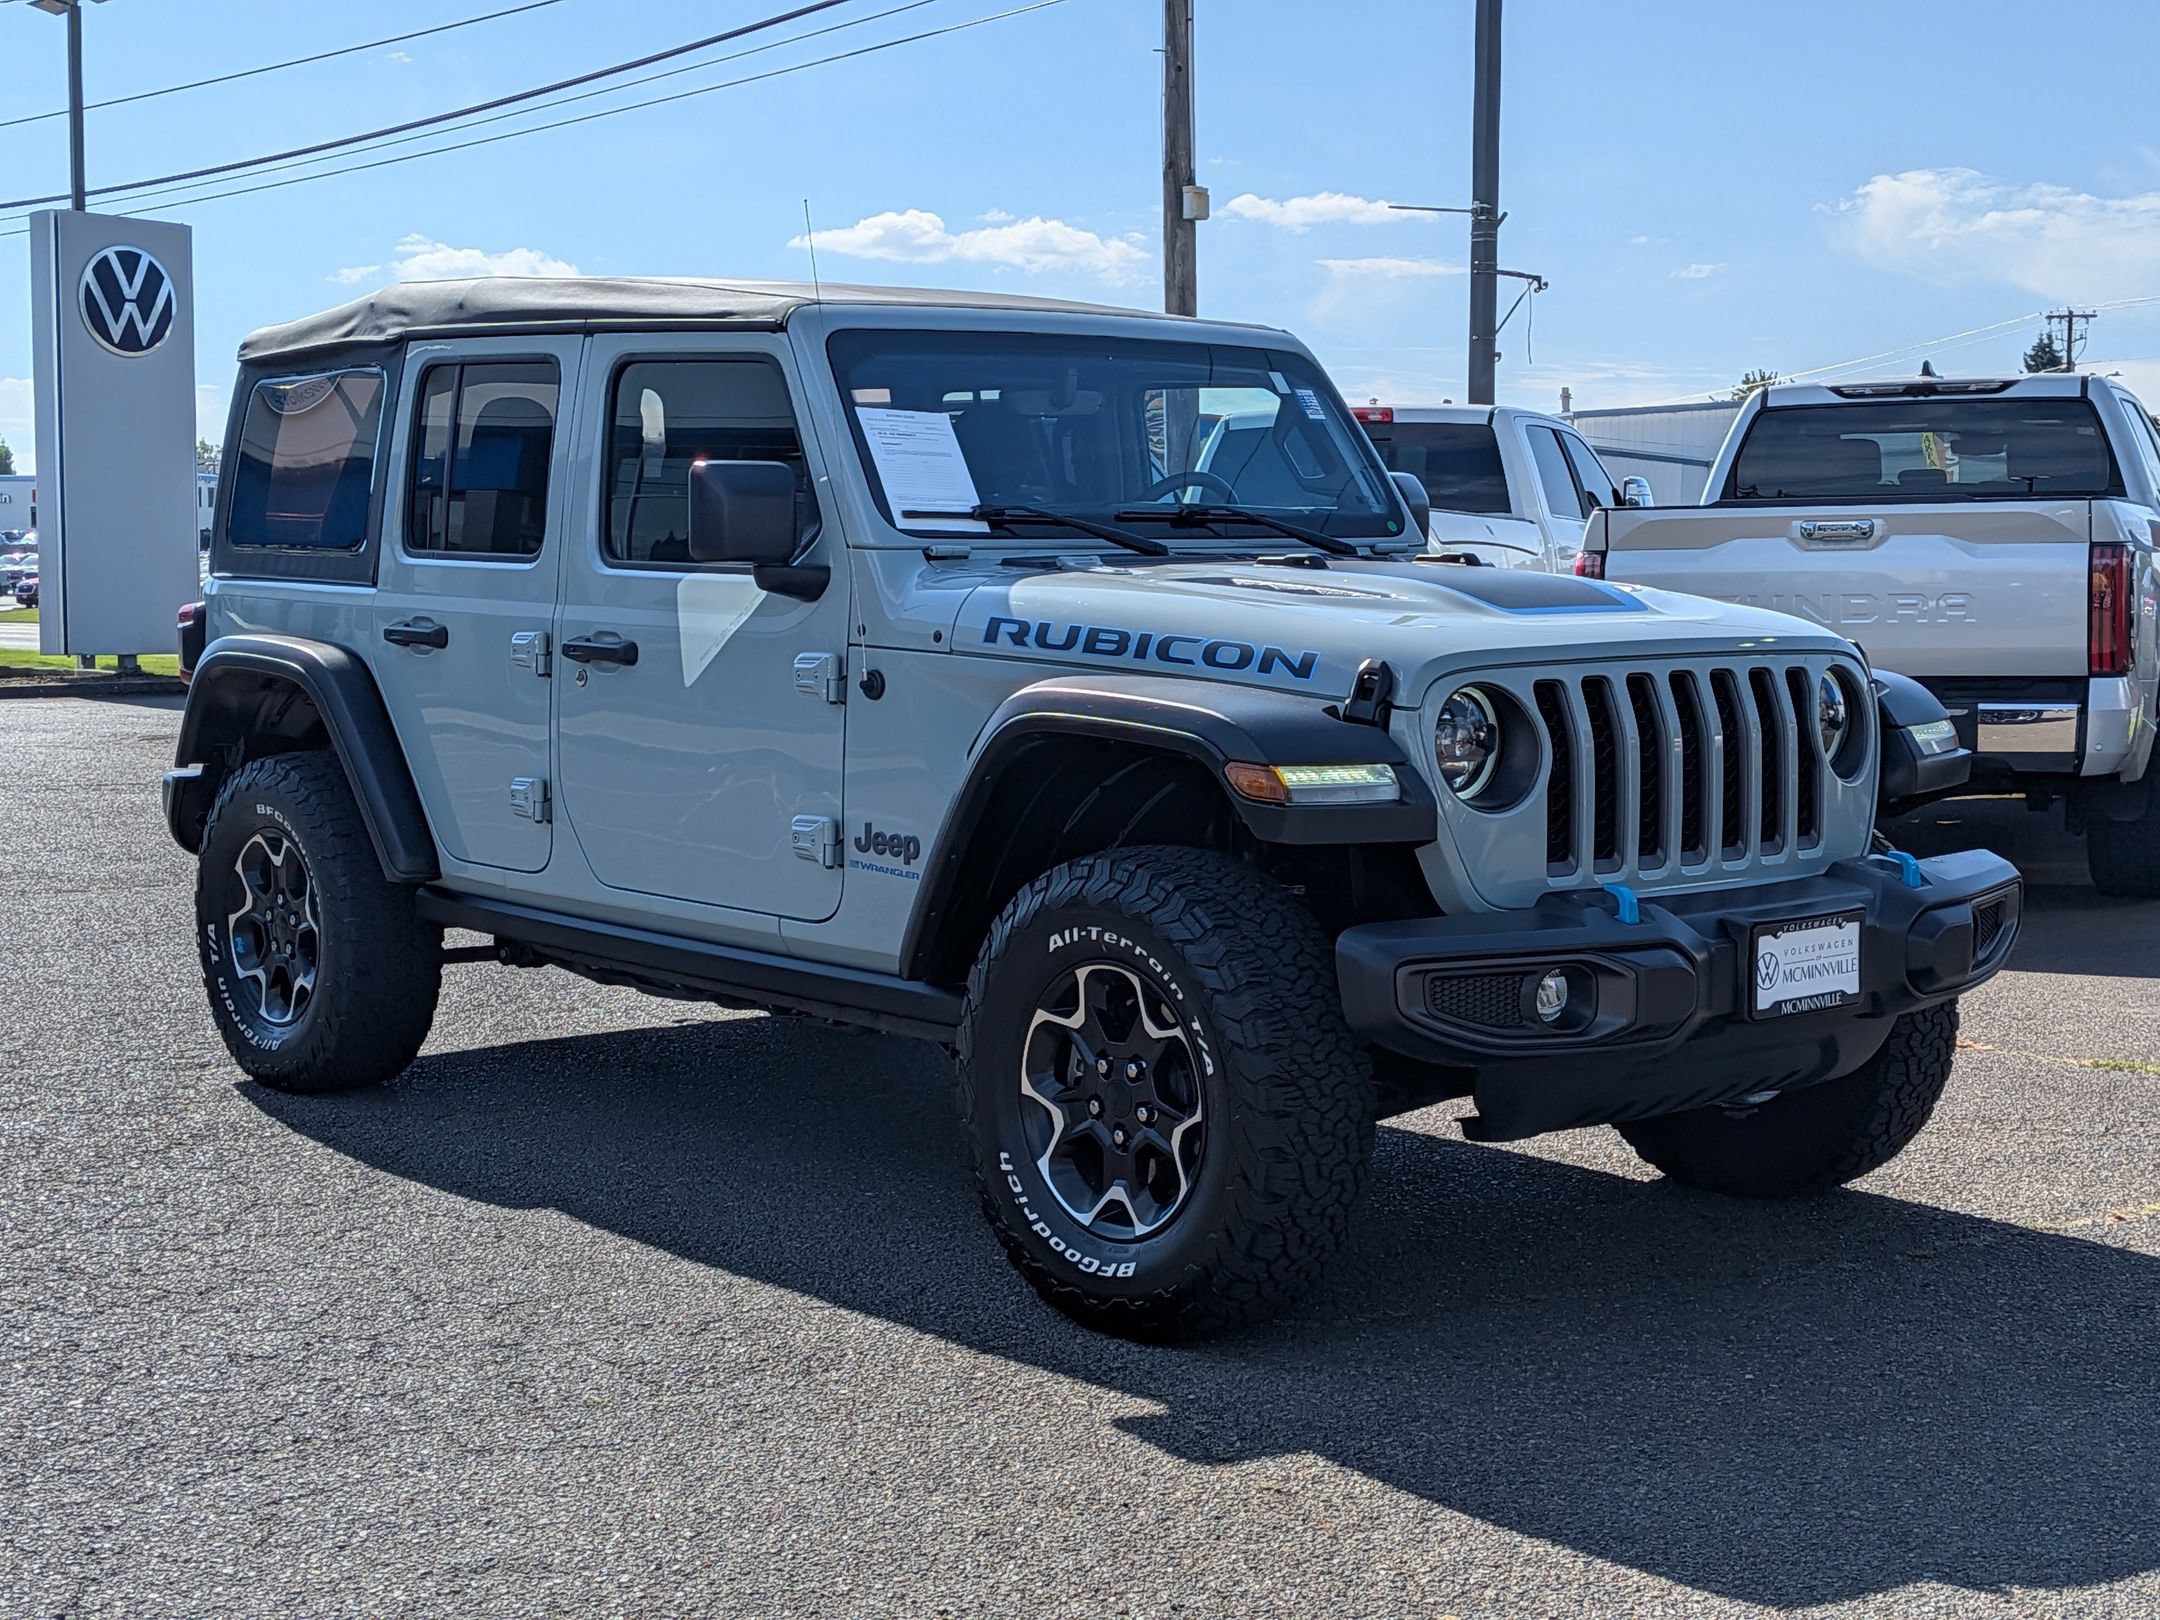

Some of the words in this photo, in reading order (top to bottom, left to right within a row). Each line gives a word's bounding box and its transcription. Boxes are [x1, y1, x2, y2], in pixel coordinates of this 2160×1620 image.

[80, 247, 177, 350] VW
[981, 614, 1321, 681] RUBICON
[854, 822, 921, 866] Jeep
[860, 860, 920, 881] WRANGLER
[1782, 916, 1843, 933] VOLKSWAGEN
[1783, 938, 1854, 958] VOLKSWAGEN
[1781, 957, 1858, 985] MCMINNVILLE
[1048, 925, 1185, 1001] All-Terrain
[1190, 1014, 1214, 1077] T/A
[1780, 991, 1843, 1016] MCMINNVILLE
[999, 1151, 1137, 1278] BFGoodrich
